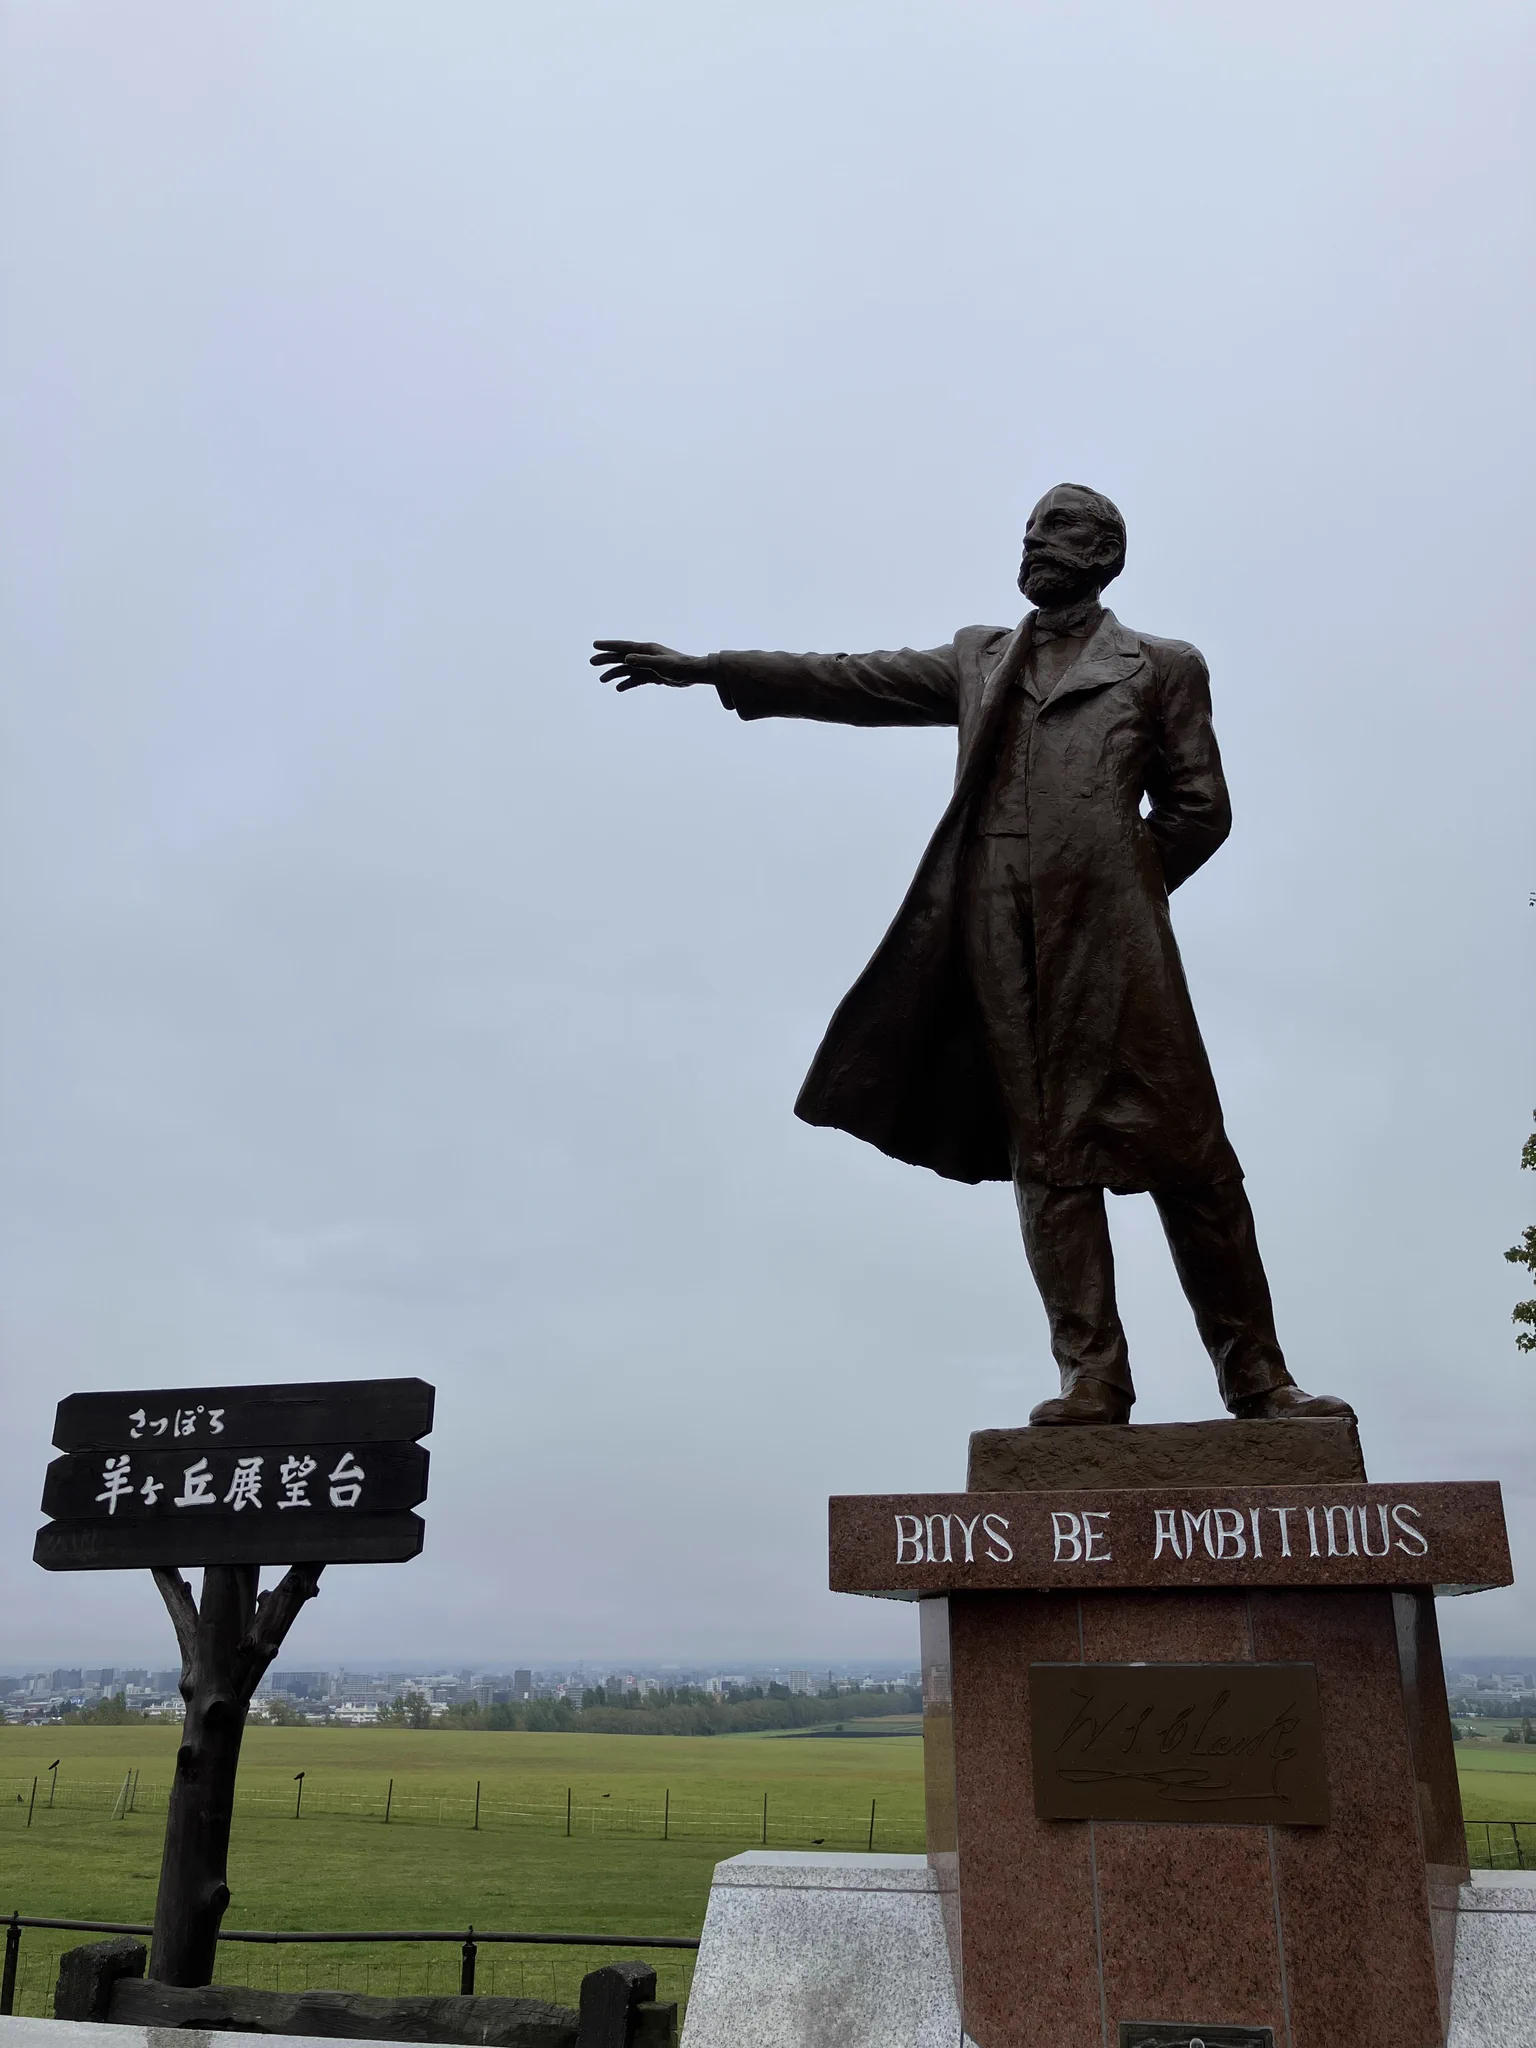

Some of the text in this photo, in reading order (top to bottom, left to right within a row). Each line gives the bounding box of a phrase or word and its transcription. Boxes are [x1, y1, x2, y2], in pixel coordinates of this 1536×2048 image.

[128, 1404, 226, 1440] さっぽろ
[894, 1503, 1429, 1565] BOYS BE AMBITIOUS
